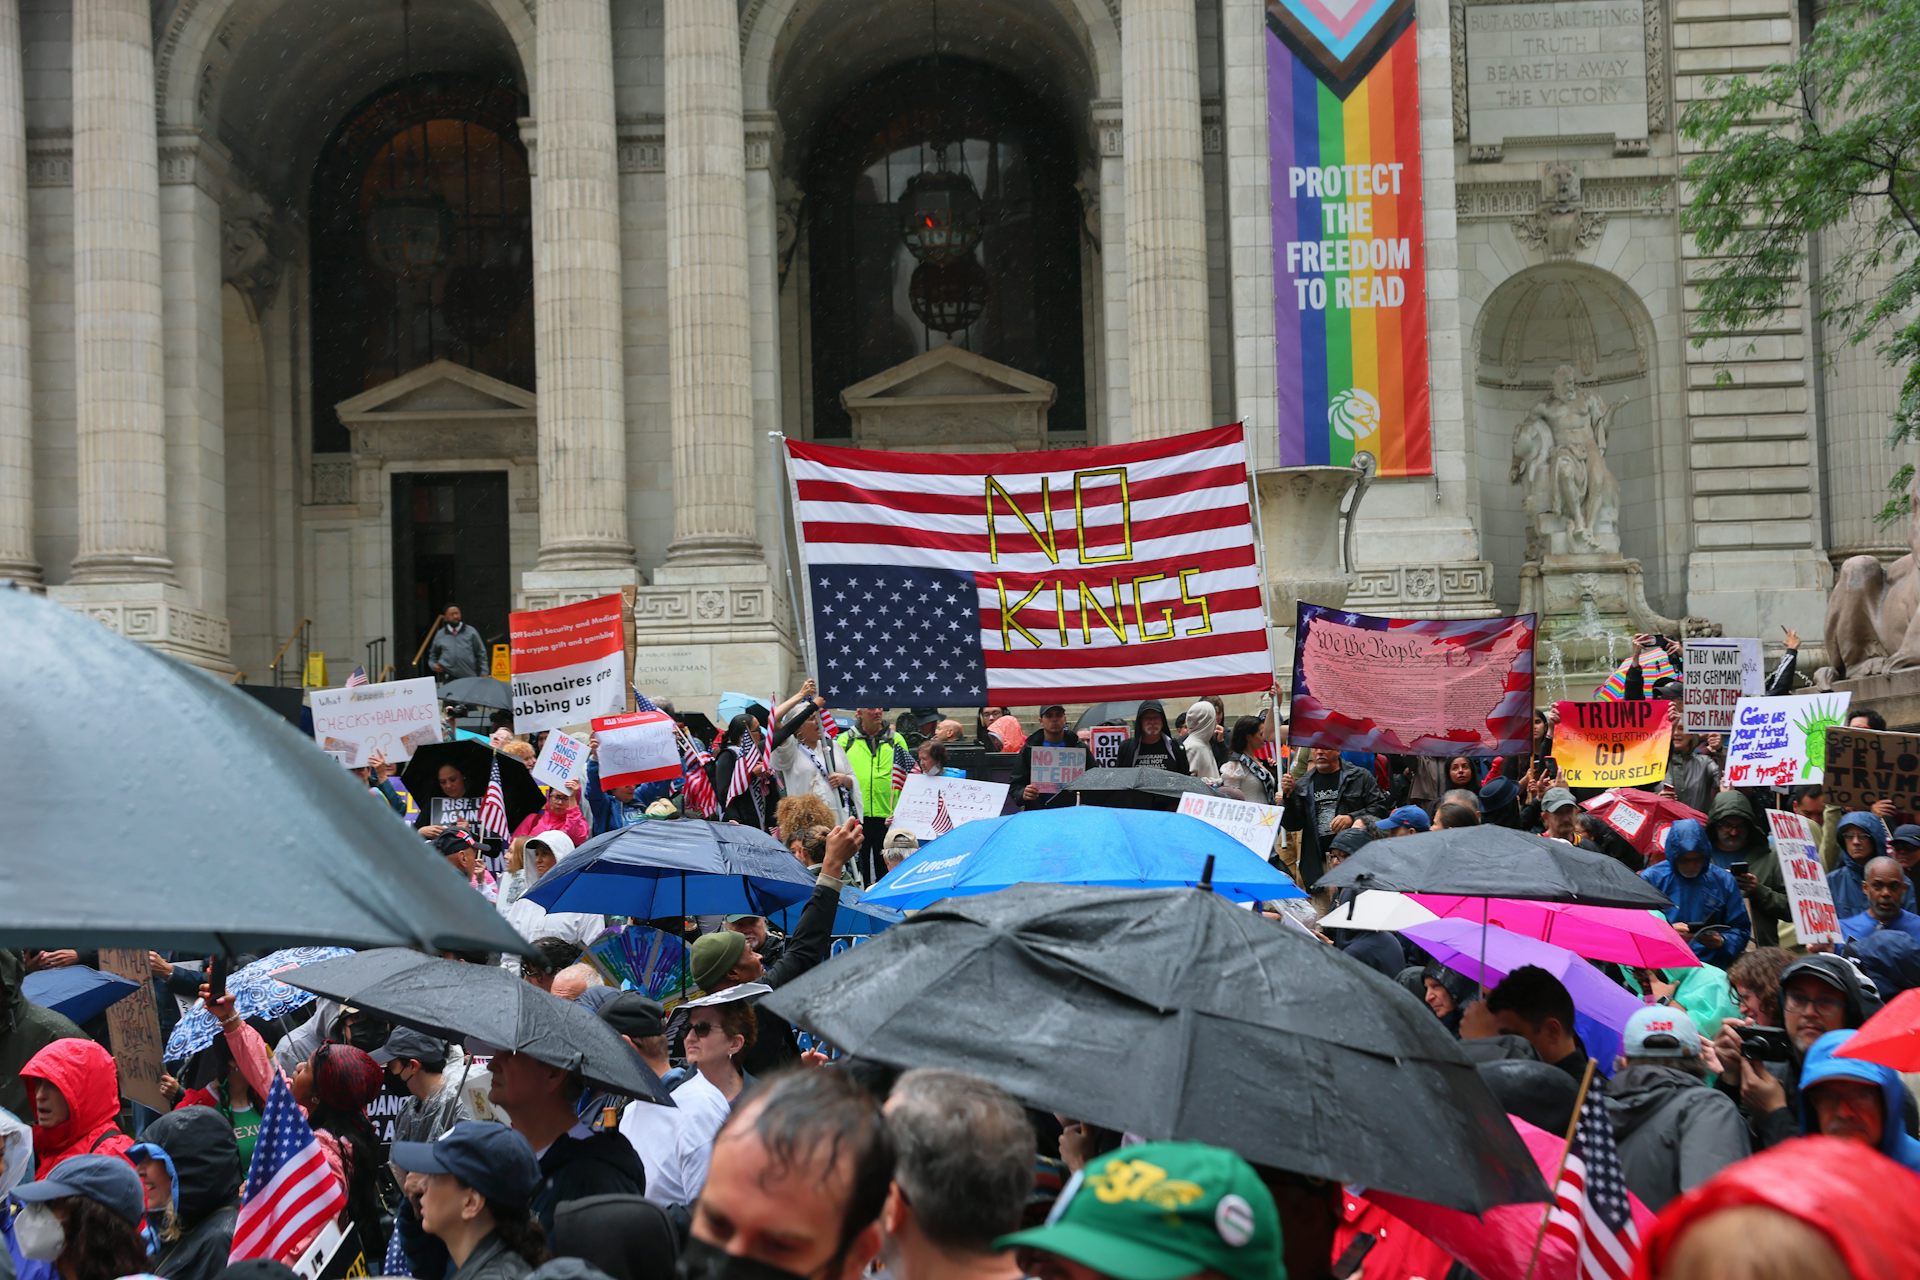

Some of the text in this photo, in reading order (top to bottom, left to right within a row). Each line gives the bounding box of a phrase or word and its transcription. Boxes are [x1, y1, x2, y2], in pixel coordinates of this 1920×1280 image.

[1471, 8, 1639, 30] BUT ABOVE ALL THINGS
[1523, 36, 1586, 54] TRUTH
[1487, 60, 1629, 81] BEARETH AWAY
[1496, 86, 1622, 107] THE VICTORY
[1288, 163, 1404, 198] PROTECT
[1321, 202, 1373, 234] THE
[1286, 238, 1411, 273] FREEDOM
[1293, 276, 1406, 310] TO READ
[984, 466, 1133, 564] NO
[996, 567, 1213, 652] KINGS
[524, 628, 543, 638] Social
[545, 625, 573, 636] Security
[575, 620, 590, 629] and
[526, 646, 549, 655] crypto
[551, 641, 567, 651] grift
[568, 638, 583, 646] and
[584, 631, 615, 644] gambling
[1366, 636, 1423, 664] People
[1685, 648, 1741, 665] THEY WANT
[596, 668, 612, 682] are
[639, 664, 708, 673] SCHWARZMAN
[1686, 669, 1742, 686] 1939 GERMANY
[576, 695, 591, 707] us
[1702, 688, 1719, 705] GIVE
[1720, 688, 1742, 706] THEM
[316, 712, 370, 733] CHECKS
[375, 703, 433, 725] BALANCES
[1574, 701, 1652, 729] TRUMP
[1686, 710, 1706, 726] 1789
[1740, 706, 1785, 726] Give us
[558, 735, 569, 746] NO
[1097, 734, 1122, 746] OH
[1731, 728, 1759, 744] your
[1826, 730, 1882, 752] Send
[551, 751, 573, 769] SINCE
[554, 743, 577, 760] KINGS
[1032, 750, 1053, 766] NO
[1095, 747, 1119, 758] HEL
[1595, 743, 1625, 766] GO
[1827, 743, 1919, 772] FELO
[547, 760, 570, 780] 1776
[1728, 764, 1752, 782] NOT
[1182, 797, 1256, 823] NO KINGS
